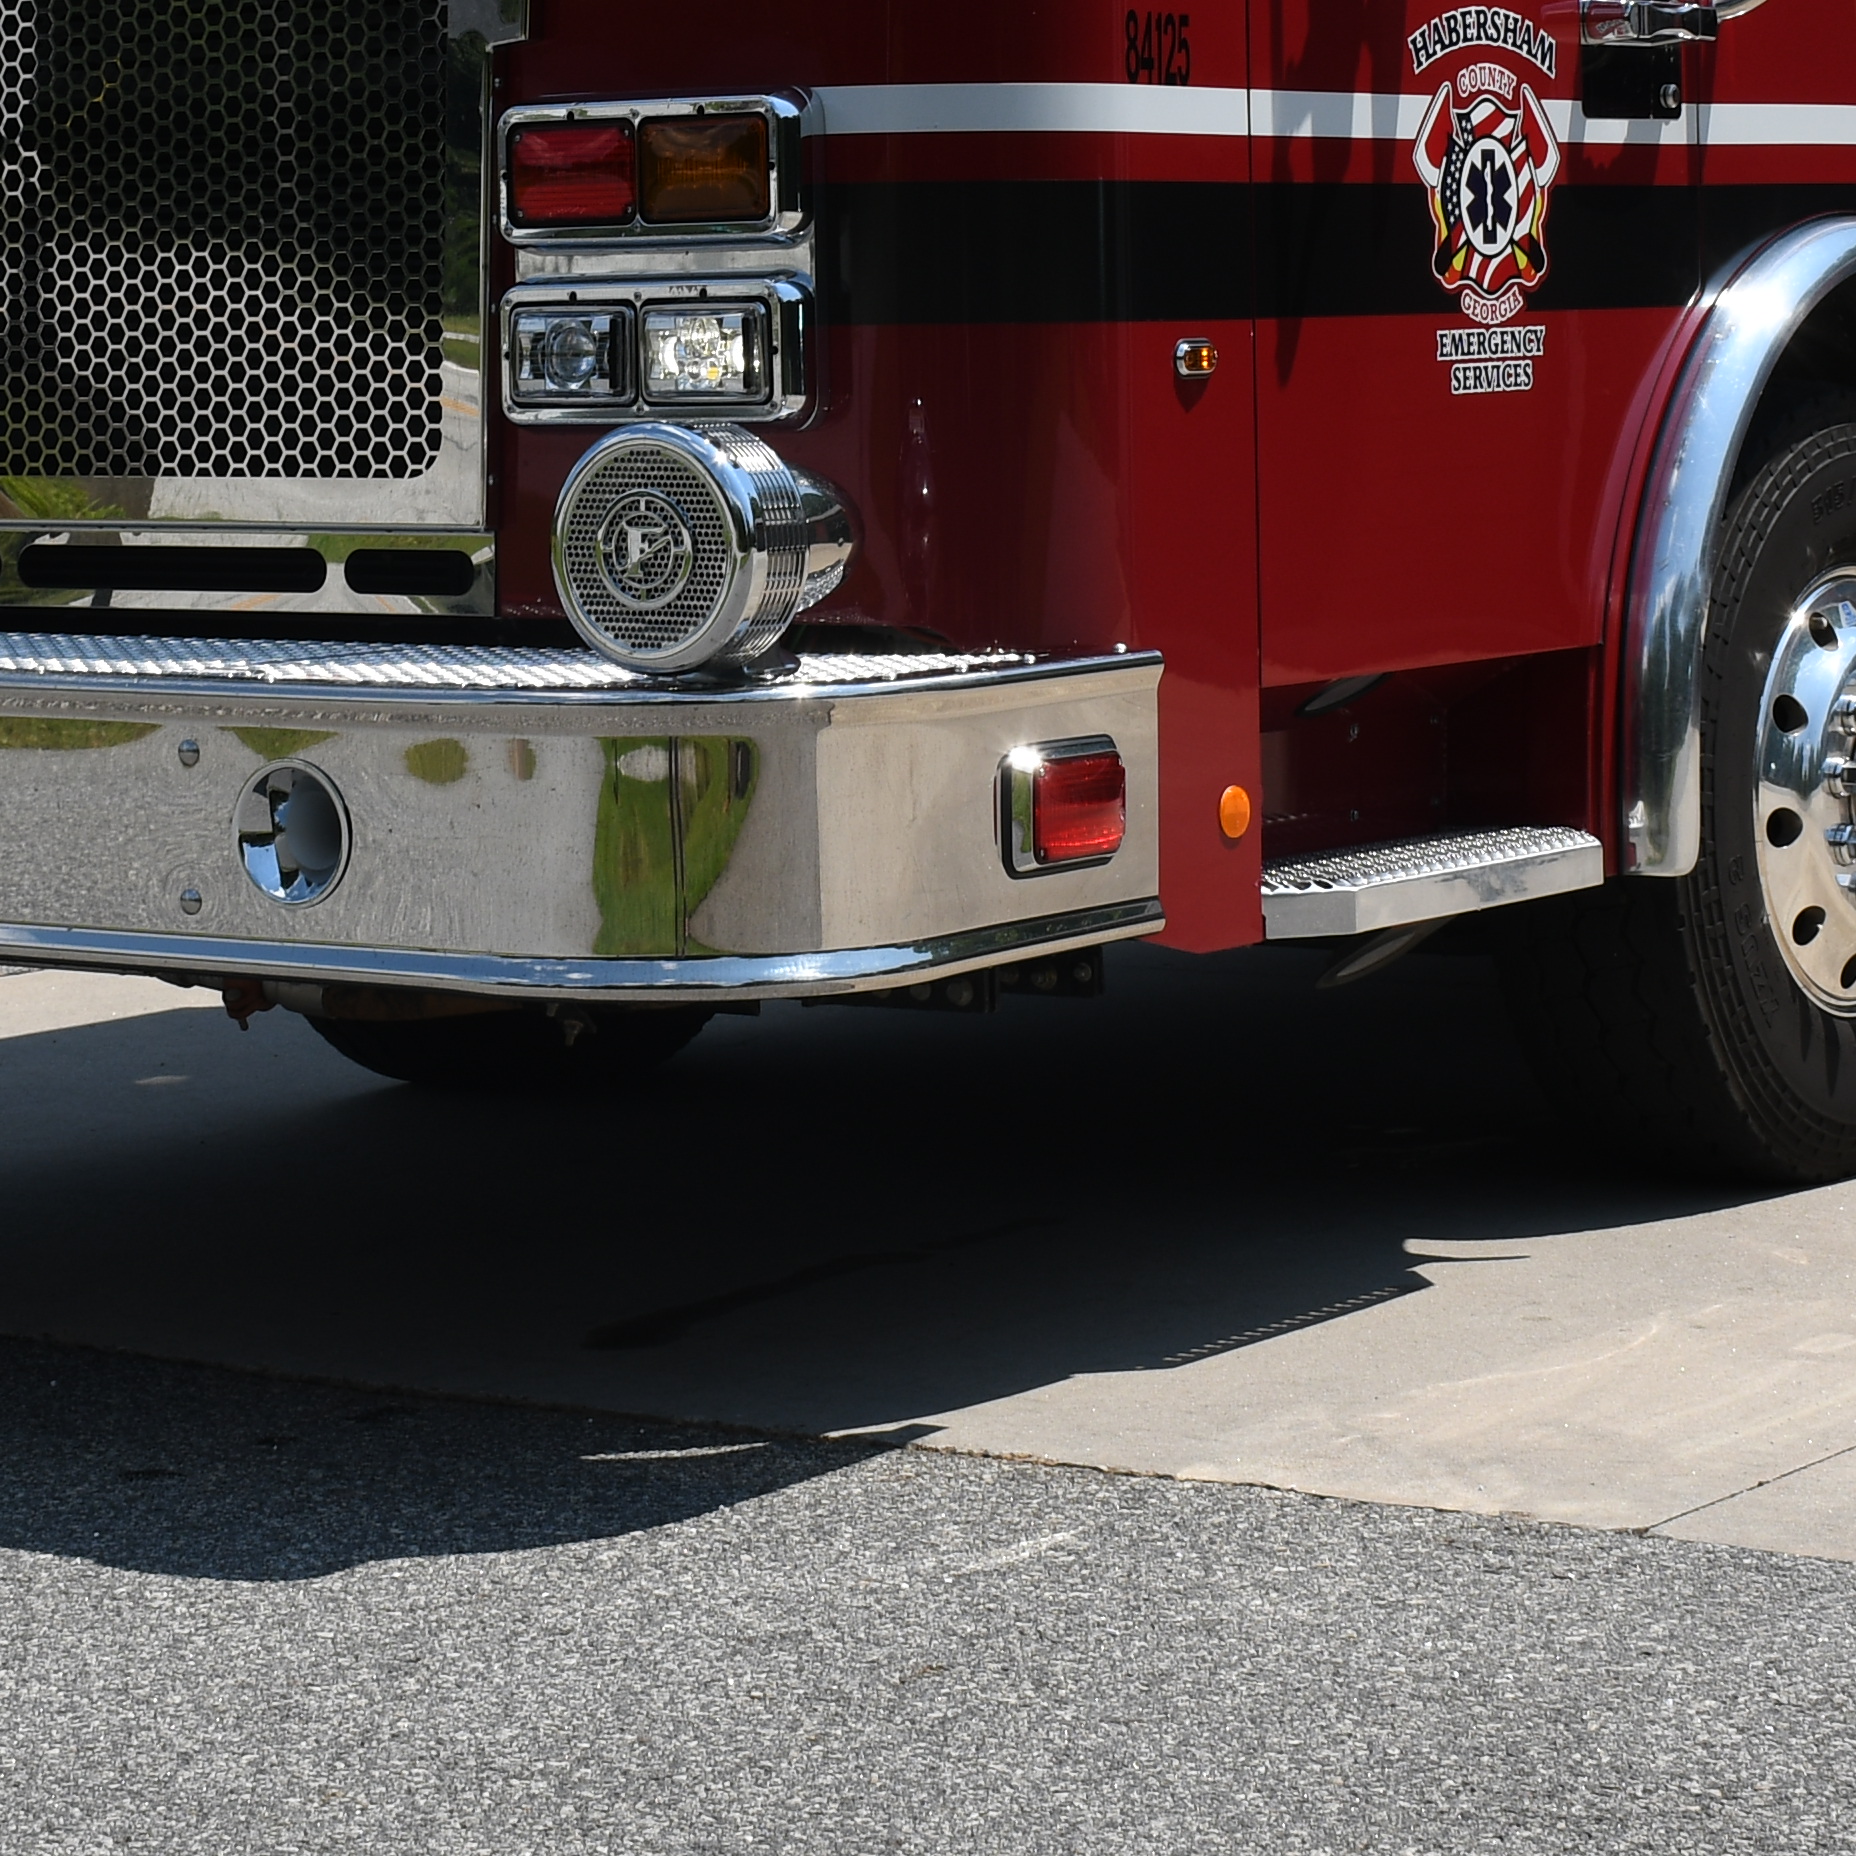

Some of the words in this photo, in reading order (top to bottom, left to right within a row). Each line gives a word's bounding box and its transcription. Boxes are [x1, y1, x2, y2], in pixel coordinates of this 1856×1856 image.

[1125, 9, 1191, 86] 84125
[1409, 6, 1556, 78] HABERSHAM
[1457, 63, 1517, 99] COUNTY
[1461, 286, 1523, 324] GEORGIA
[1437, 327, 1544, 360] EMERGENCY
[1451, 361, 1532, 394] SERVICES
